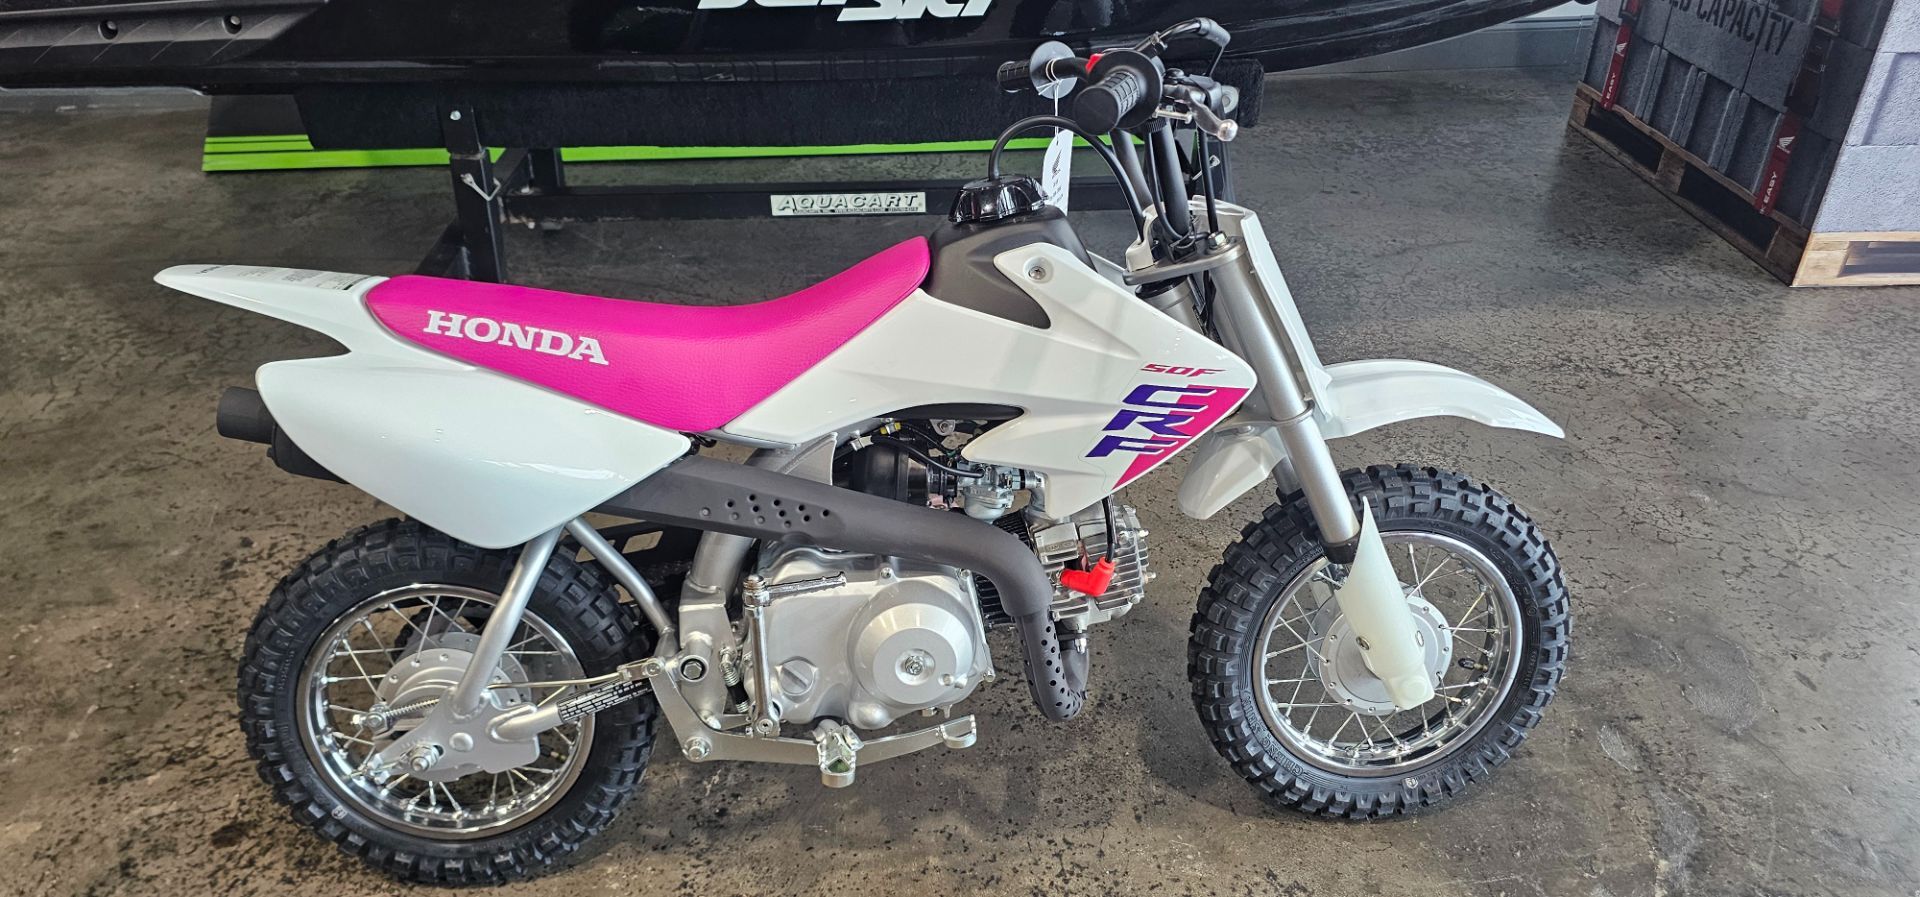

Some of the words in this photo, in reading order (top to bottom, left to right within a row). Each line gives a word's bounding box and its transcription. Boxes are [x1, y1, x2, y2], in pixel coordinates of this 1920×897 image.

[1697, 0, 1793, 55] CAPACITY
[778, 193, 919, 210] AQUACART
[1763, 171, 1777, 203] EASY
[423, 310, 609, 366] HONDA
[1085, 384, 1217, 457] CRF
